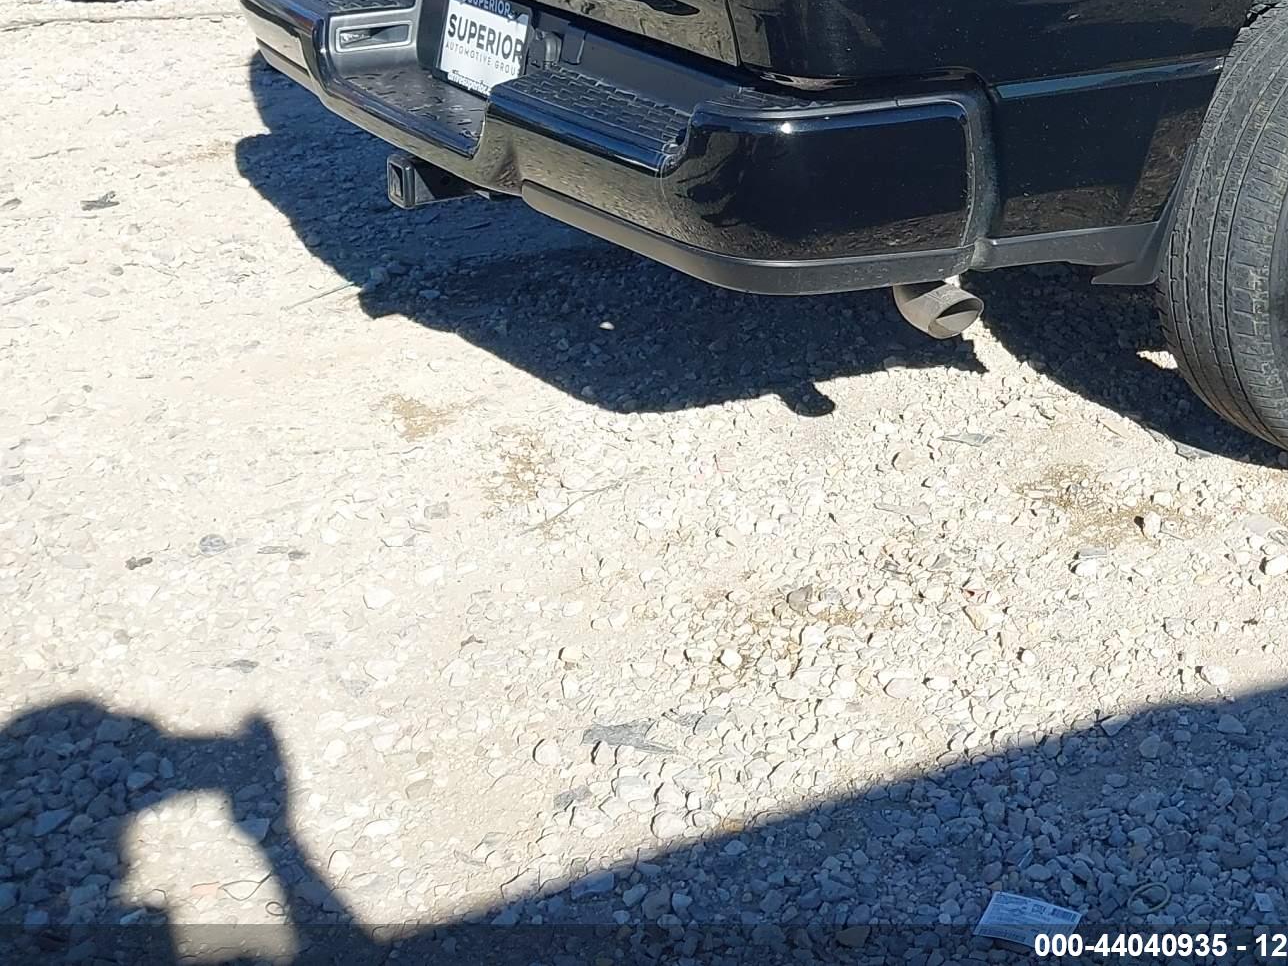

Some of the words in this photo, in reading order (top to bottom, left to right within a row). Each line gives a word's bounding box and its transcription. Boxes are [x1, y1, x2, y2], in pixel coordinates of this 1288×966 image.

[445, 41, 493, 67] AUTOMOTIVE
[494, 60, 520, 76] GROU
[447, 13, 525, 63] SUPERIOR
